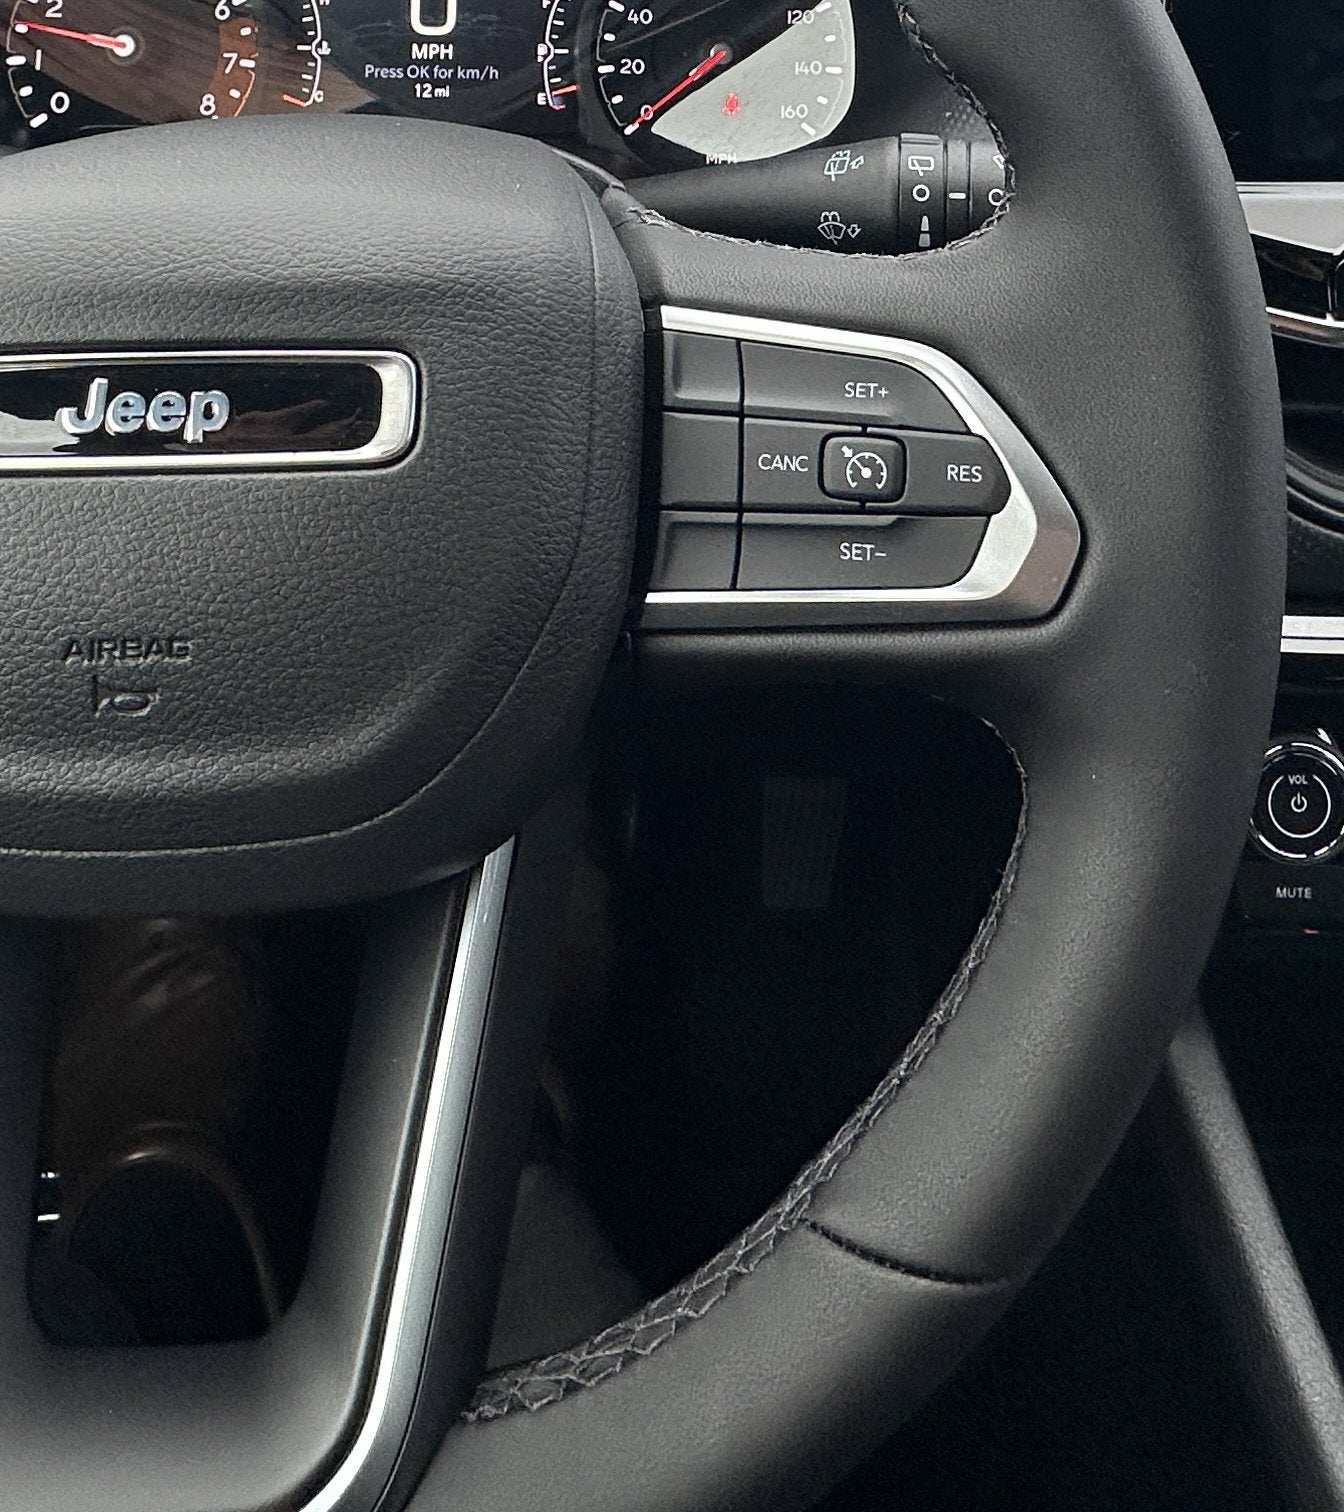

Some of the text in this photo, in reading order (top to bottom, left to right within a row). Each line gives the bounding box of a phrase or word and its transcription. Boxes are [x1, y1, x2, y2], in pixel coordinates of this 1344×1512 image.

[214, 0, 231, 21] 6
[627, 9, 653, 25] 40
[787, 10, 815, 25] 120
[411, 43, 453, 60] MPH
[34, 49, 42, 72] 1
[222, 53, 239, 74] 7
[619, 59, 645, 75] 20
[794, 61, 822, 76] 140
[364, 64, 499, 81] Press OK for km/h
[414, 84, 450, 98] 12 mi
[537, 92, 547, 106] E
[50, 92, 70, 114] 0
[199, 93, 216, 116] 8
[780, 105, 808, 119] 160
[844, 382, 889, 399] SET+
[60, 377, 230, 443] Jeep
[758, 454, 809, 472] CANC
[946, 465, 983, 483] RES
[62, 635, 193, 666] AIRBAG
[1288, 774, 1308, 786] VOL
[1275, 886, 1312, 900] MUTE
